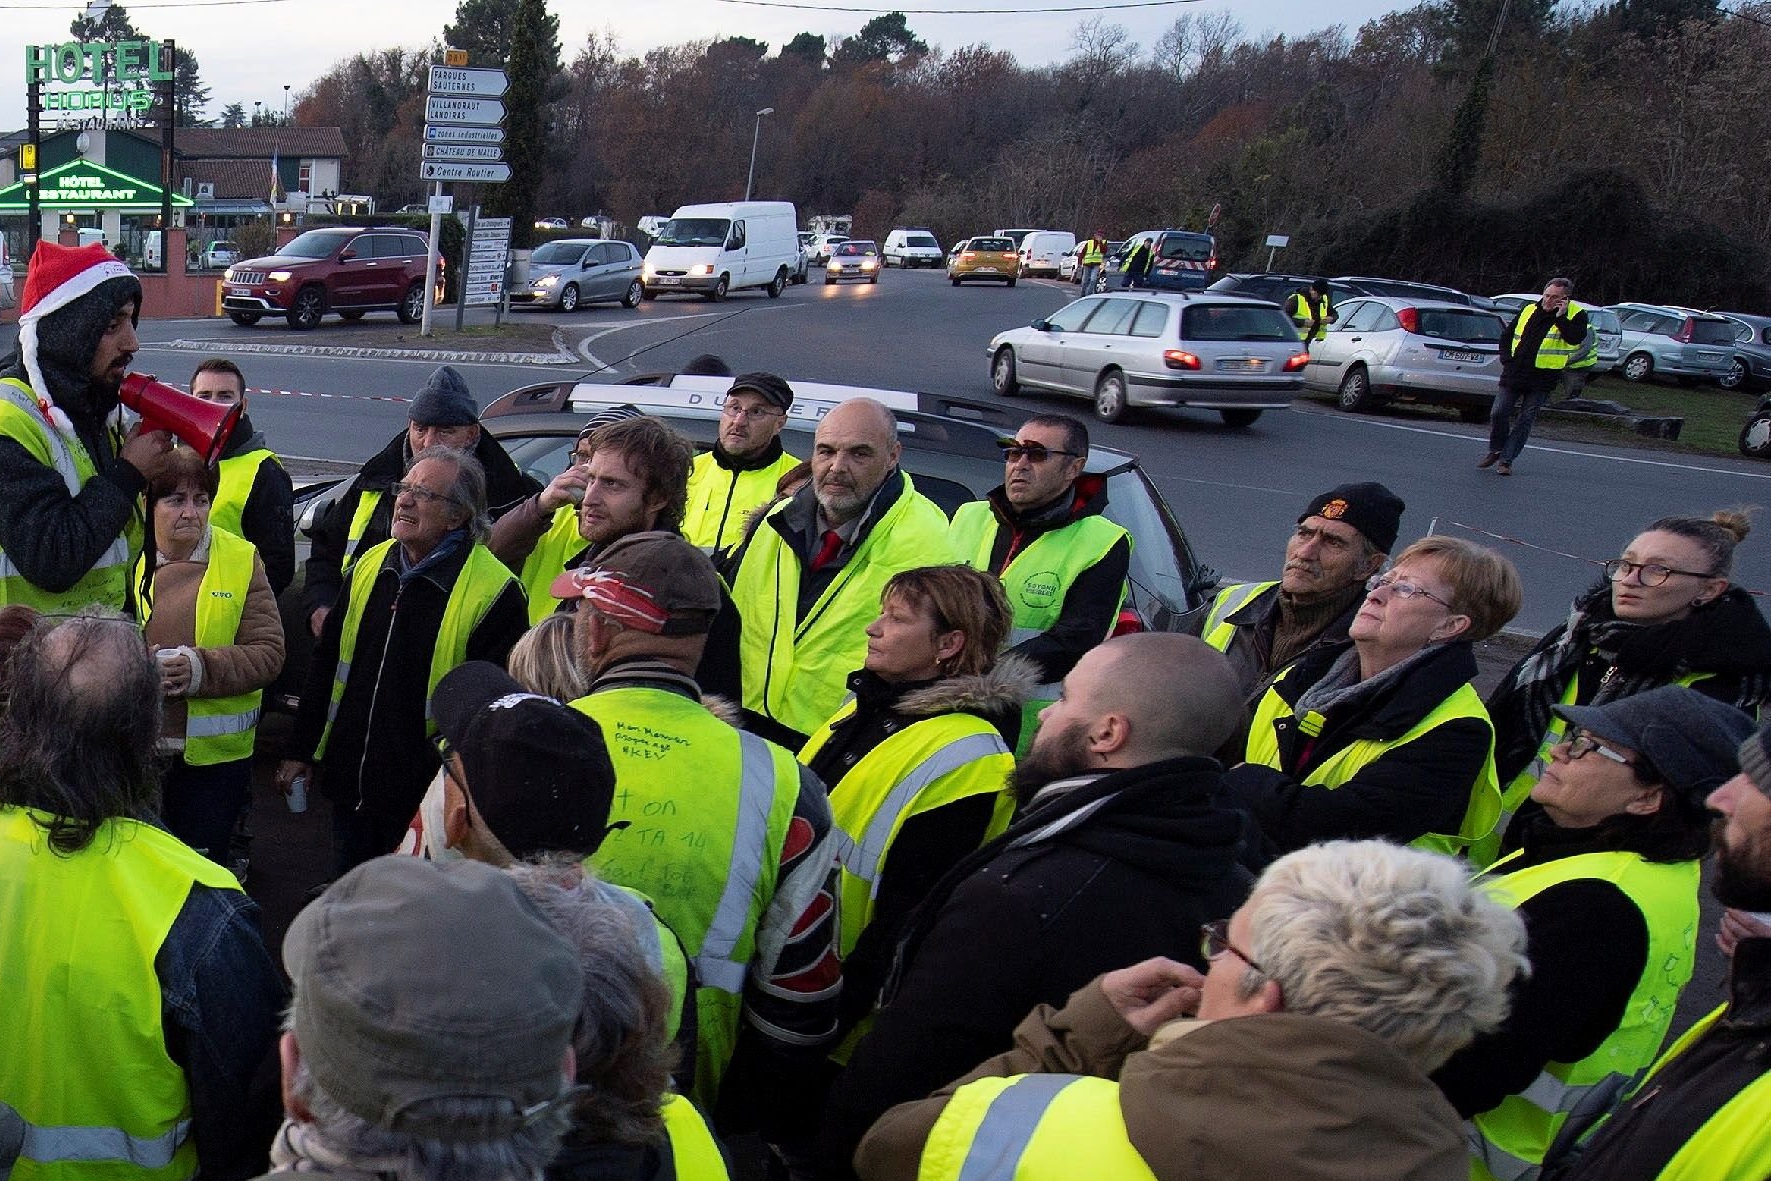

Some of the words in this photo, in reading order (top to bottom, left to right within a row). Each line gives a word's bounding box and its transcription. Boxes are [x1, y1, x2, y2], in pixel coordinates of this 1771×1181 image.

[26, 40, 173, 84] HOTEL
[434, 70, 467, 80] FARGUES
[433, 81, 476, 91] SAUTERNES
[45, 90, 152, 111] HORUS
[431, 100, 480, 110] VILLANDRAUT
[430, 111, 466, 120] LANDIRAS
[458, 129, 498, 140] industrielles
[467, 148, 476, 157] DE
[467, 167, 495, 178] Routier
[59, 174, 105, 188] HÔTEL
[688, 393, 828, 417] DUER
